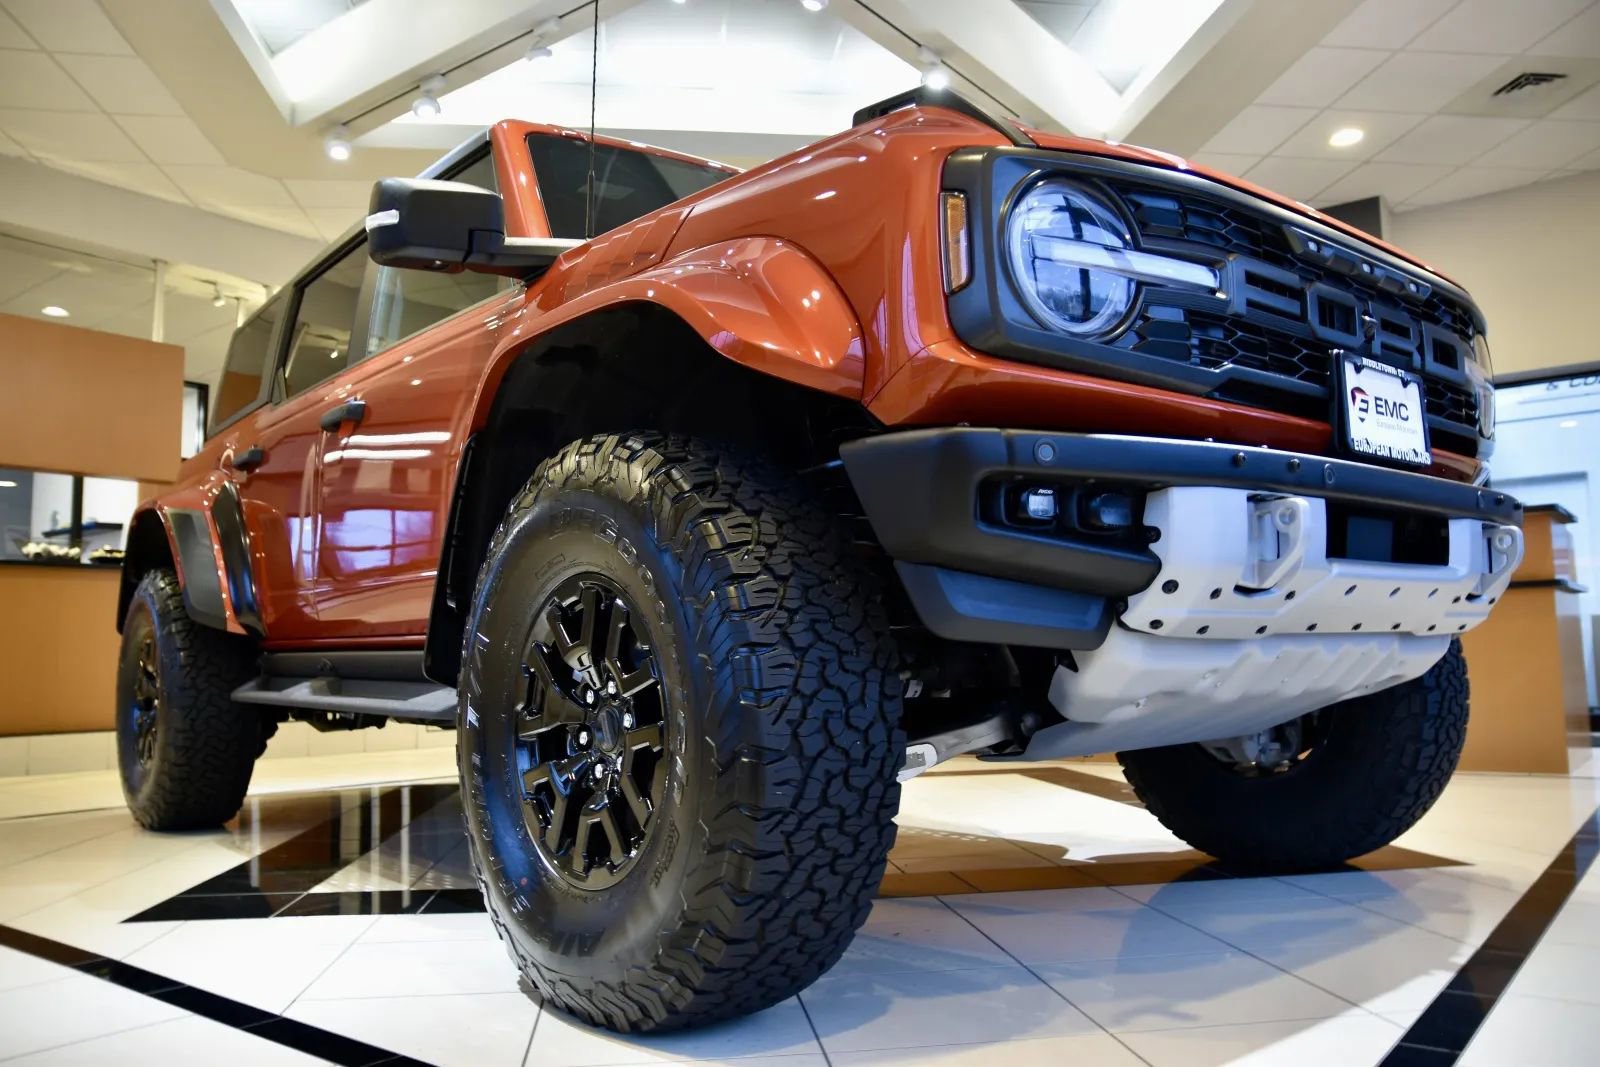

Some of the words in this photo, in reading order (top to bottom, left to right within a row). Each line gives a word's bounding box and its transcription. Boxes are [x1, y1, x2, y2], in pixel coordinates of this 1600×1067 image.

[1229, 254, 1466, 384] FORD
[1374, 396, 1409, 422] EMC
[1354, 440, 1391, 457] EUROPEAN
